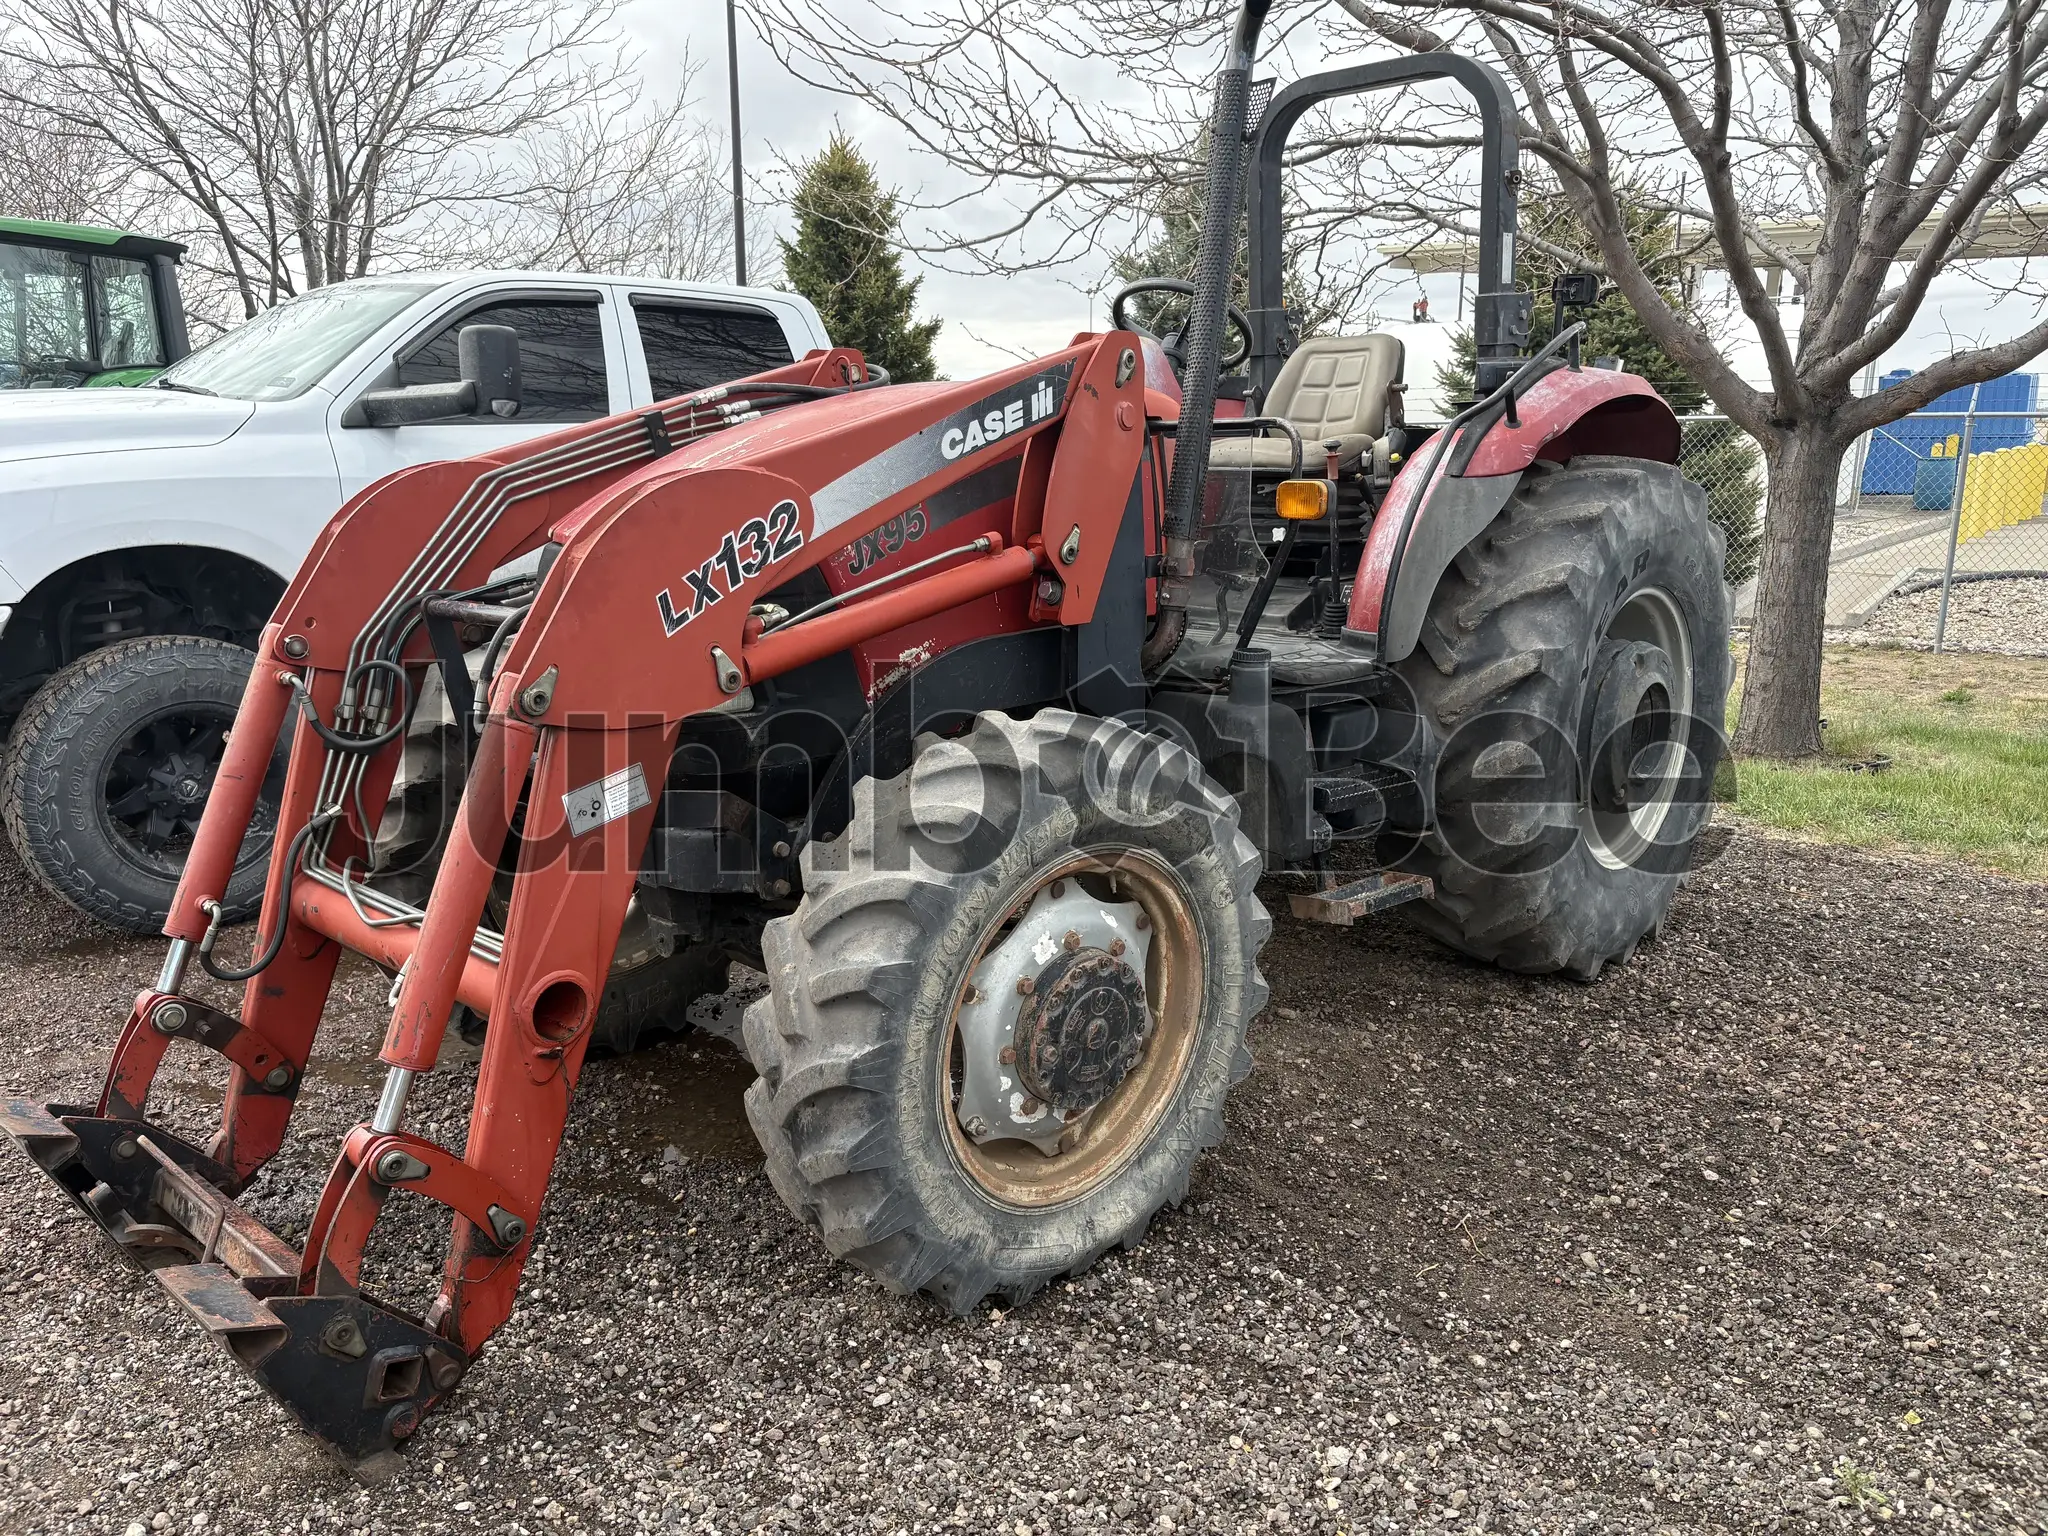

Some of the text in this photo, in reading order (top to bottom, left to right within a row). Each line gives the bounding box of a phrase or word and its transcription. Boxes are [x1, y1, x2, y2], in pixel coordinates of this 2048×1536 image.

[941, 399, 1024, 460] CASE
[656, 499, 804, 638] LX132
[847, 503, 927, 576] JX95
